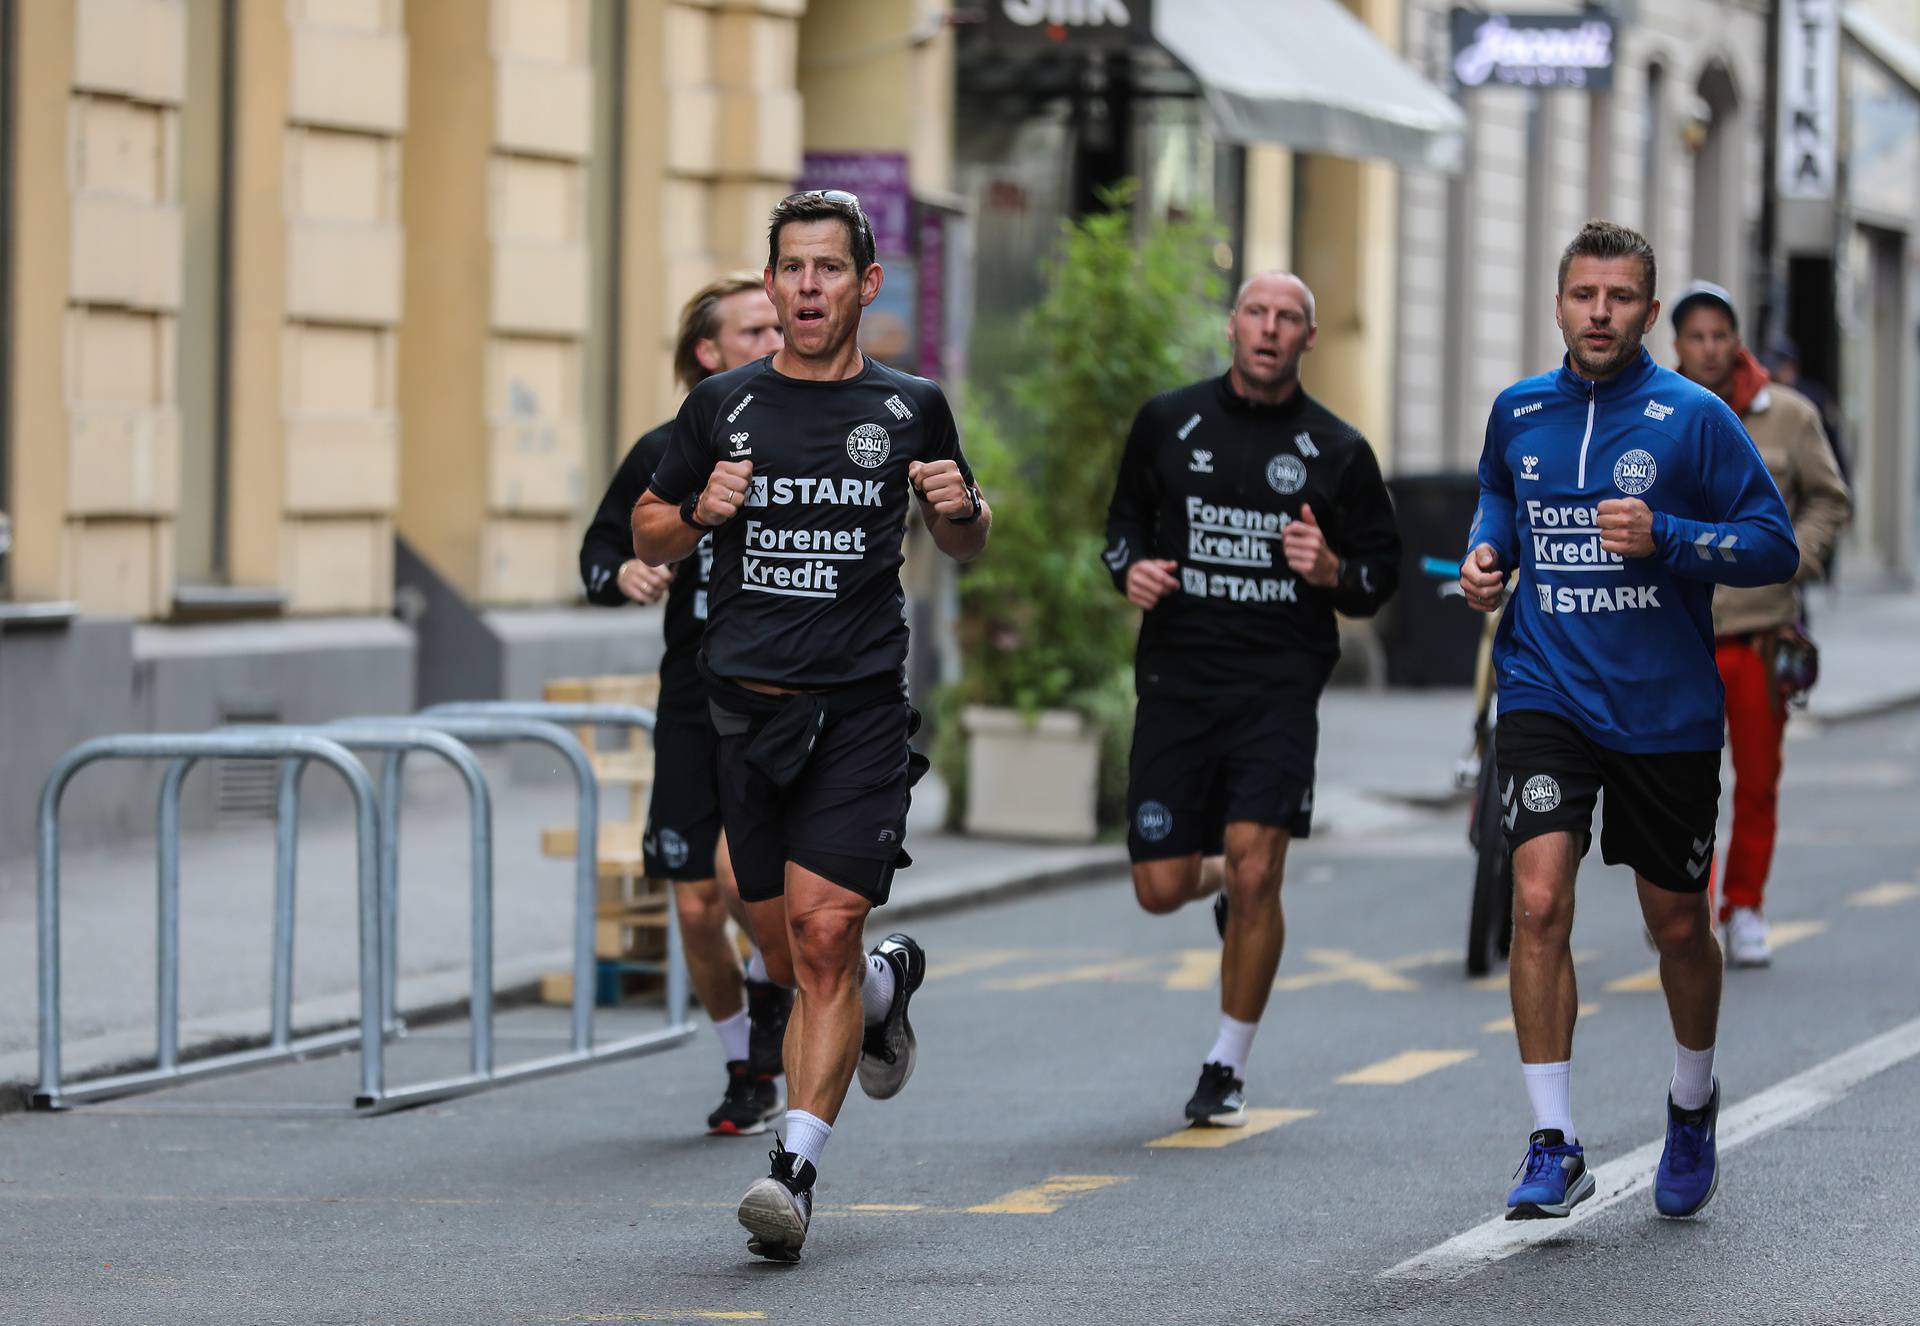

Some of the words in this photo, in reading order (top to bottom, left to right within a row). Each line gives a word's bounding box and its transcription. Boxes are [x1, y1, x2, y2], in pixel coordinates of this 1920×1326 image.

[733, 393, 754, 416] STARK
[857, 437, 882, 452] DBU
[1622, 464, 1648, 478] DBU
[772, 477, 885, 507] STARK
[1186, 496, 1292, 532] Forenet
[1526, 500, 1600, 527] Fore
[745, 520, 866, 552] Forenet
[1189, 529, 1273, 561] Kredit
[742, 556, 838, 590] Kredit
[1209, 574, 1298, 602] STARK
[1555, 585, 1661, 613] STARK
[1530, 786, 1554, 801] DBU
